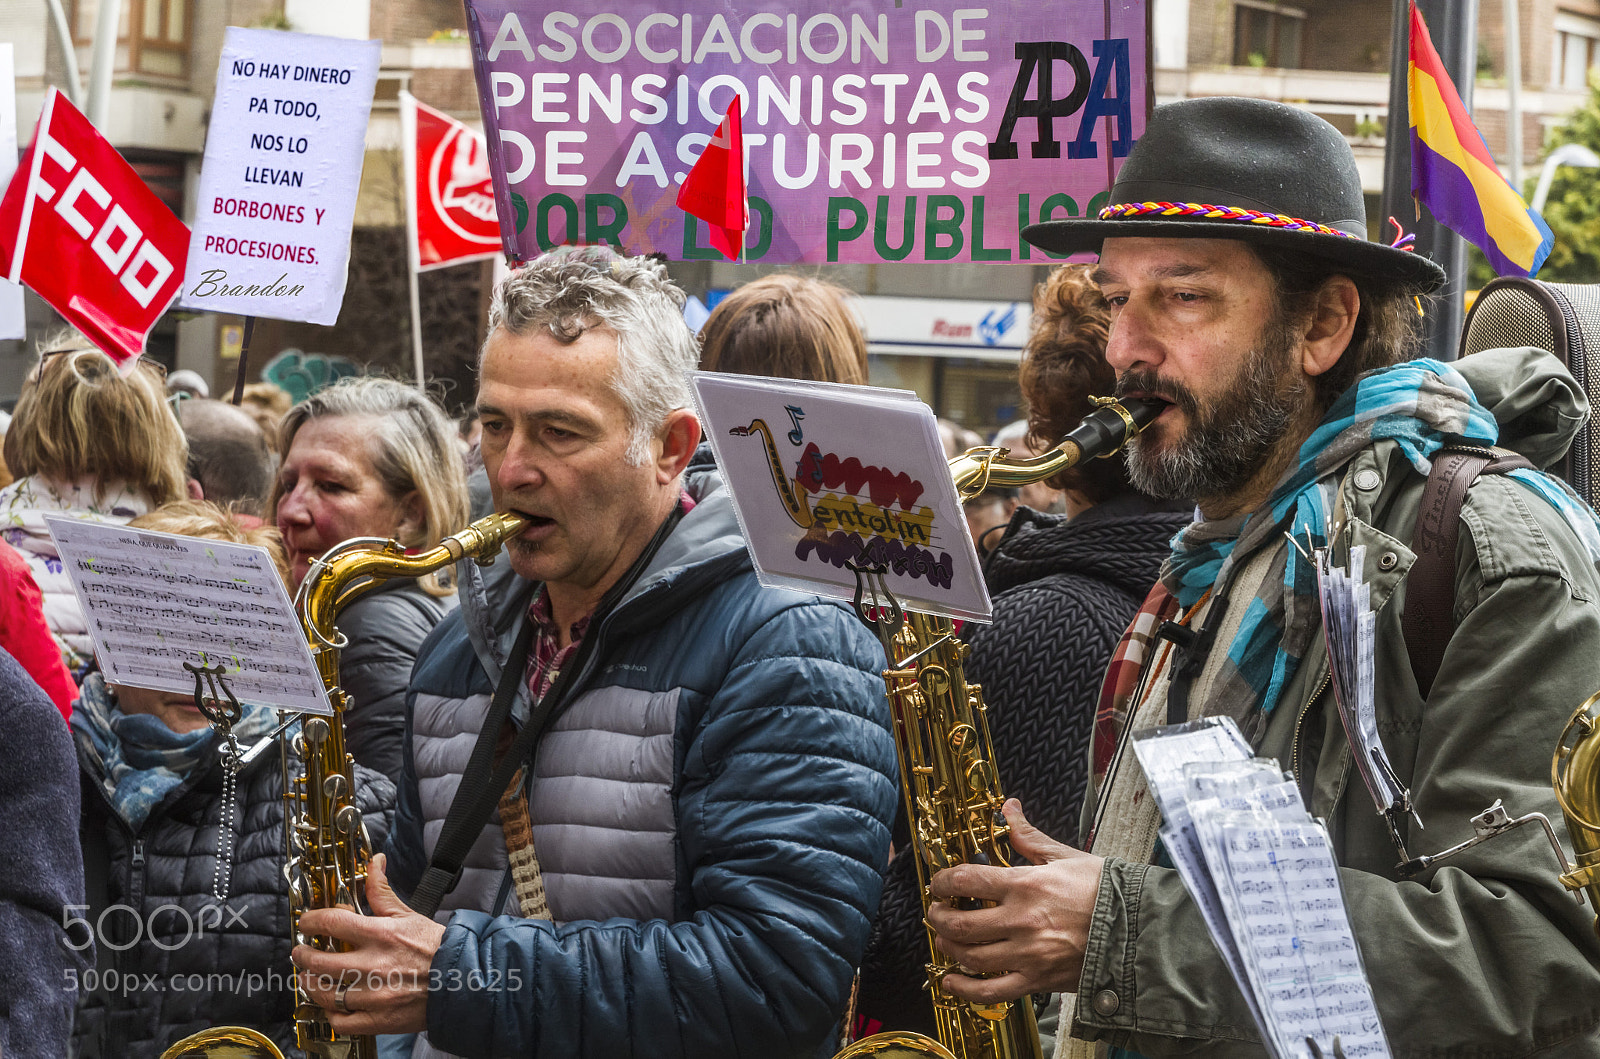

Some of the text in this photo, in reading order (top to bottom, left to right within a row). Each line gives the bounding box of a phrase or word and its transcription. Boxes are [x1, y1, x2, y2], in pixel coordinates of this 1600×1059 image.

[487, 8, 990, 64] ASOCIACION DE
[232, 60, 351, 85] NO HAY DINERO
[249, 97, 321, 121] PA TODO,
[490, 71, 990, 126] PENSIONISTAS
[251, 133, 308, 154] NOS LO
[499, 128, 588, 187] DE
[244, 166, 303, 188] LLEVAN
[213, 197, 326, 226] BORBONES Y
[826, 190, 1110, 262] PUBLIC
[204, 235, 319, 265] PROCESIONES.
[813, 502, 927, 542] entolin
